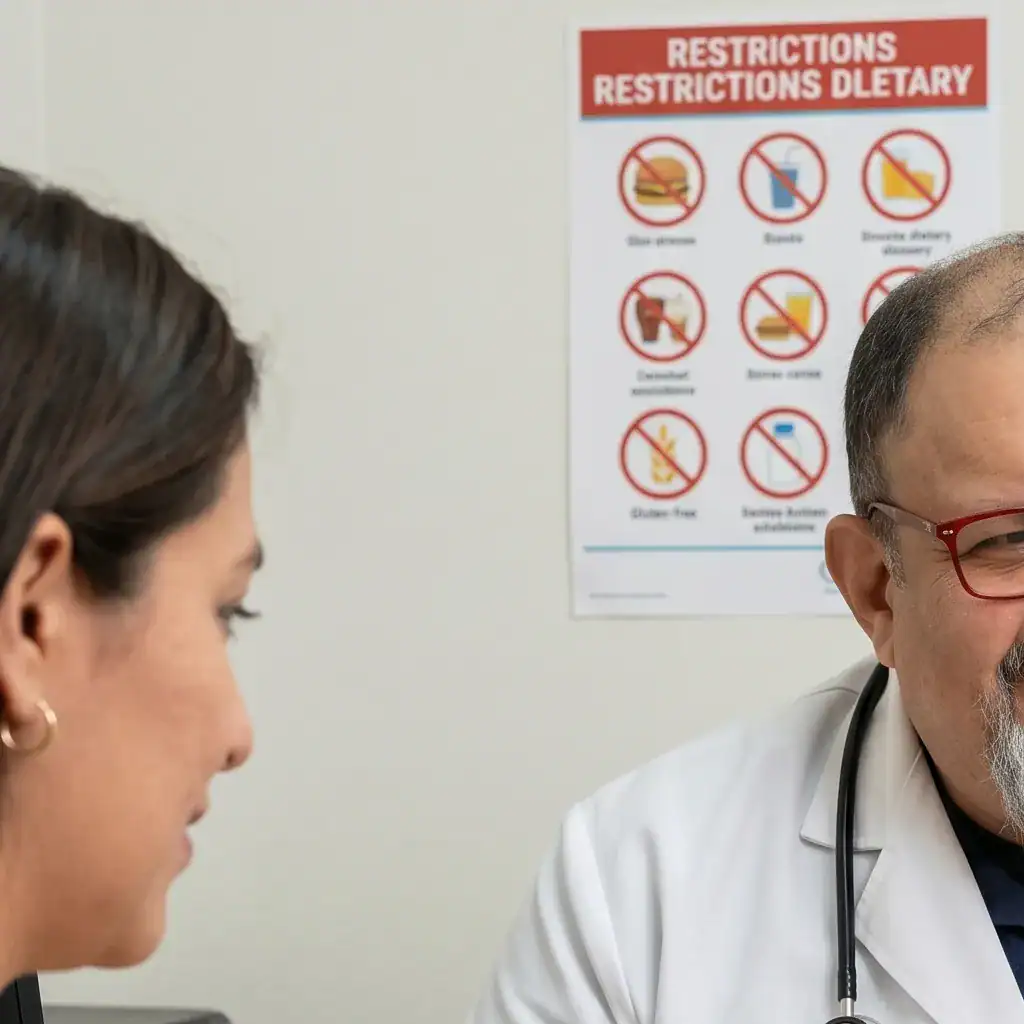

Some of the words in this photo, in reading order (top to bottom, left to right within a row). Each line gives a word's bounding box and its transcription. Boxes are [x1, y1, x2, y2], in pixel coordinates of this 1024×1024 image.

[667, 31, 898, 68] RESTRICTIONS
[593, 68, 822, 107] RESTRICTIONS
[831, 63, 974, 100] DLETARY
